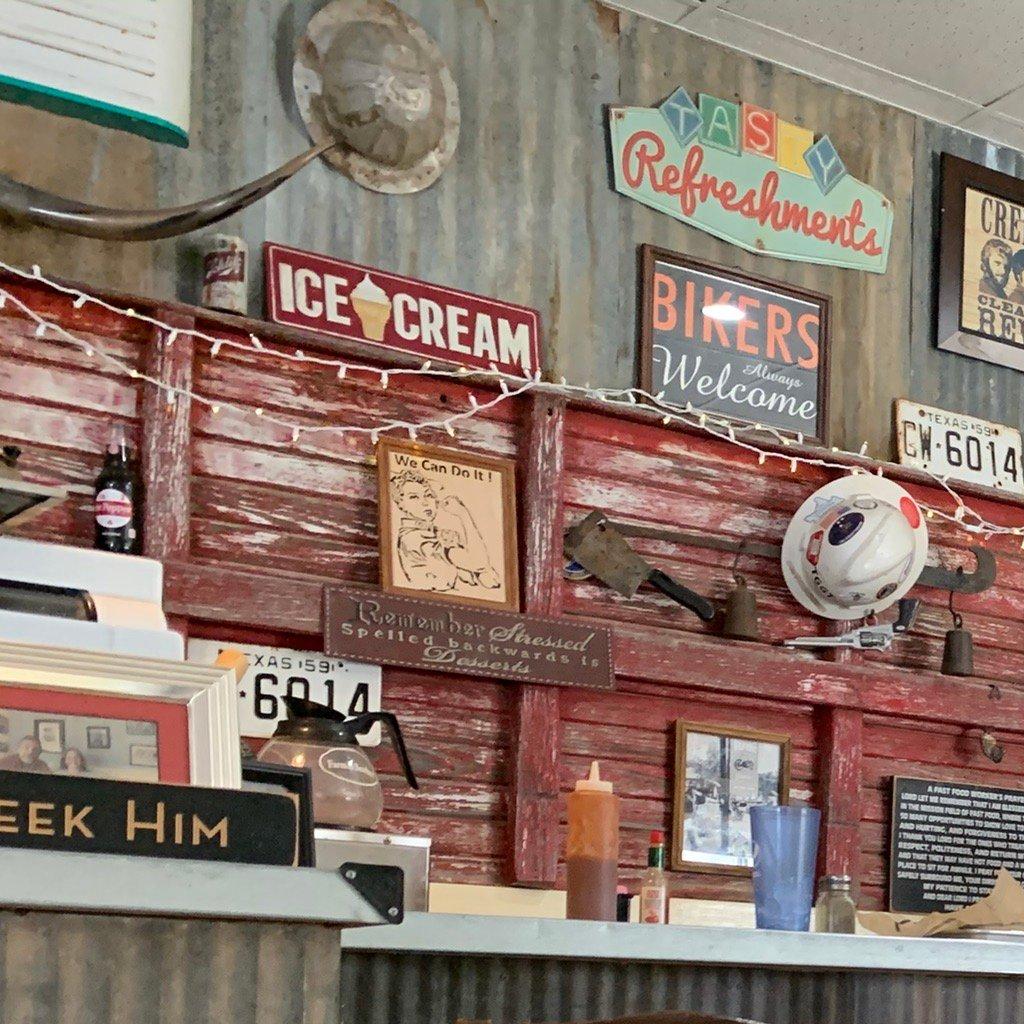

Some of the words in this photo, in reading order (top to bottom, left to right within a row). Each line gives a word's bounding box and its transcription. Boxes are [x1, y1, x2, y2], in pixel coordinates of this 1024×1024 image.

[661, 101, 835, 190] TASY
[622, 130, 882, 256] Refreshments
[278, 263, 351, 326] ICE
[393, 293, 532, 371] CREAM
[653, 273, 819, 370] BIKERS
[652, 344, 817, 420] Welcome
[743, 363, 803, 390] Always
[927, 412, 968, 430] TEXAS
[394, 454, 417, 468] We
[421, 459, 447, 474] Can
[451, 465, 470, 480] Do
[474, 470, 484, 481] It
[945, 430, 1017, 482] 6014
[341, 622, 434, 646] Spelled
[449, 638, 570, 664] backwards
[581, 655, 600, 668] is
[348, 595, 485, 638] Remember
[489, 622, 595, 653] Stressed
[422, 645, 530, 674] Desserts
[126, 799, 229, 848] HIM
